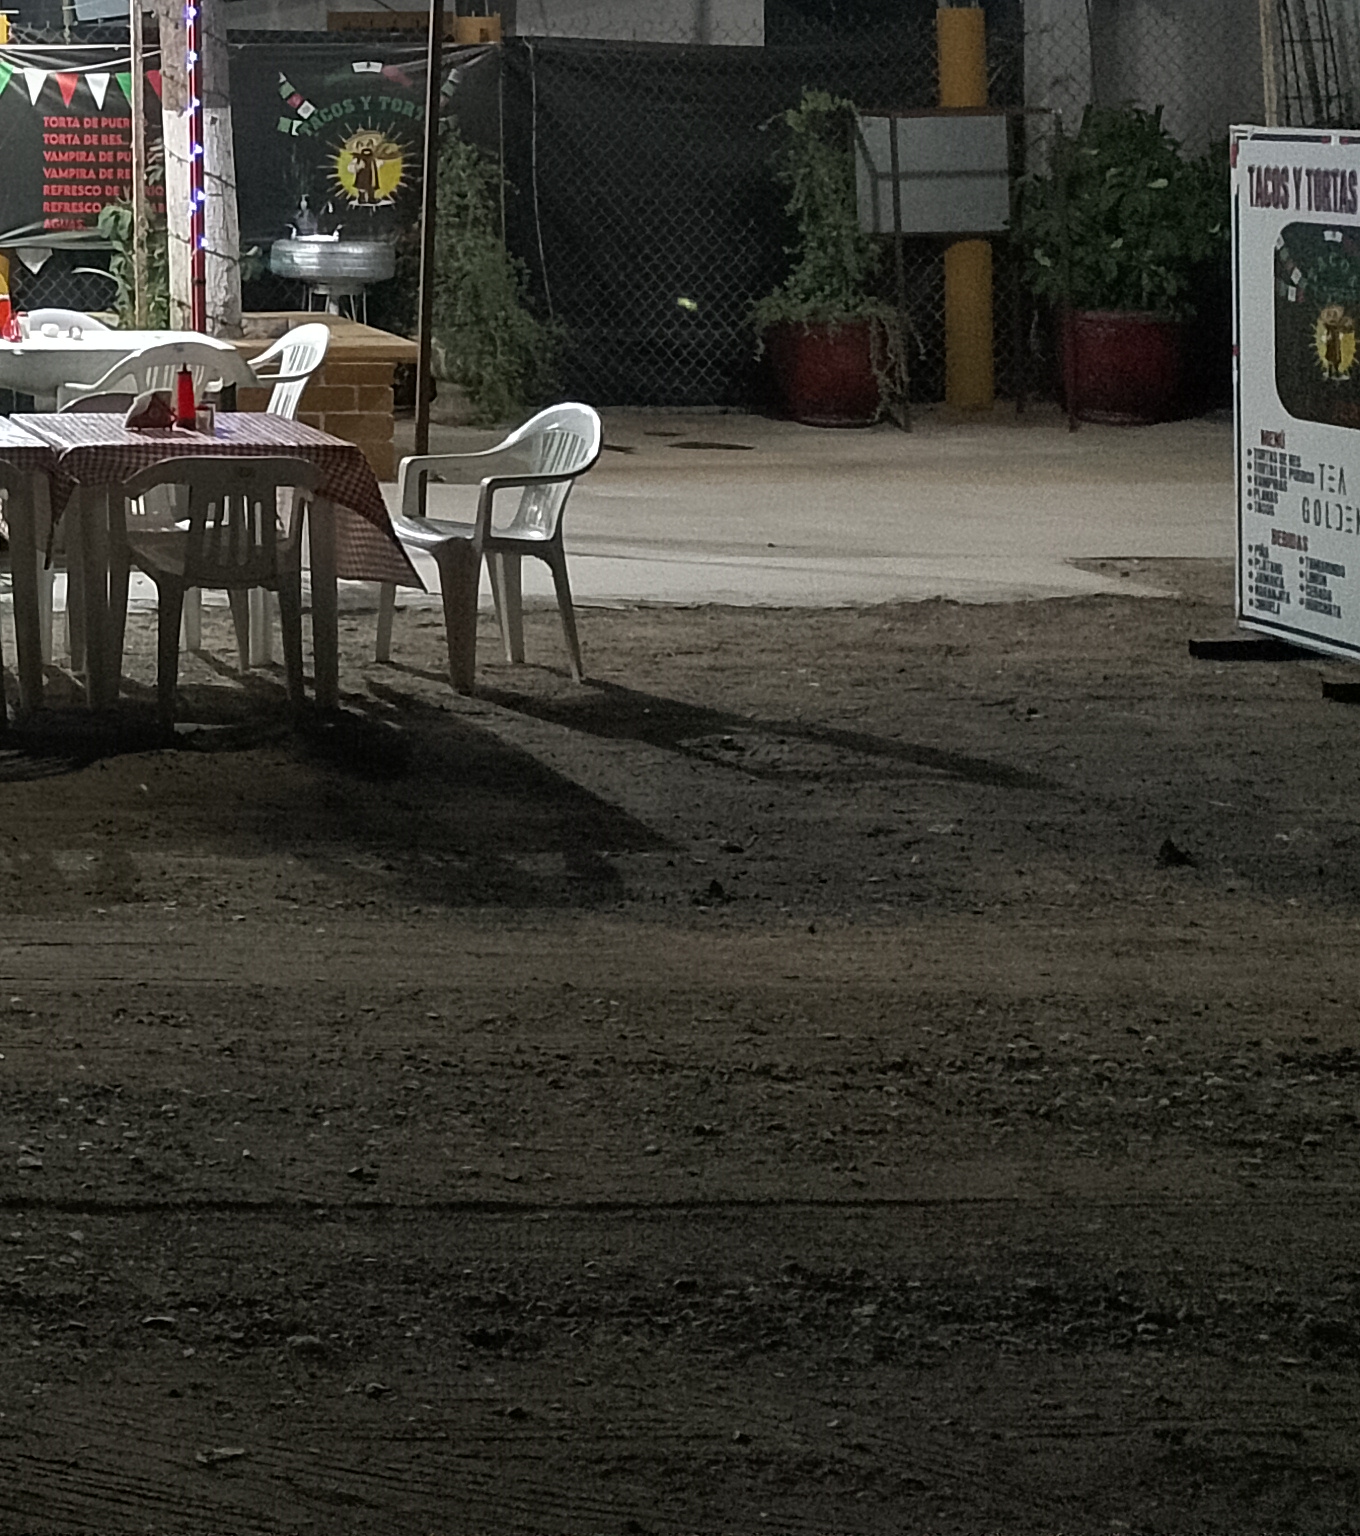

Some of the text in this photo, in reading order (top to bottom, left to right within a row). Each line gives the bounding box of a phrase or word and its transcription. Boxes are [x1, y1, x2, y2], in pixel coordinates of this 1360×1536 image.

[360, 95, 372, 110] Y
[43, 116, 80, 129] TORTA
[83, 117, 99, 129] DE
[43, 133, 80, 145] TORTA
[83, 134, 99, 145] DE
[43, 150, 97, 162] VAMPIRA
[99, 151, 114, 162] DE
[43, 167, 97, 180] VAMPIRA
[99, 168, 114, 180] DE
[43, 185, 102, 196] REFRESCO
[105, 185, 120, 196] DE
[1247, 164, 1358, 215] TACOS Y TORTAS
[43, 202, 102, 213] REFRESCO
[1319, 463, 1347, 496] TEA
